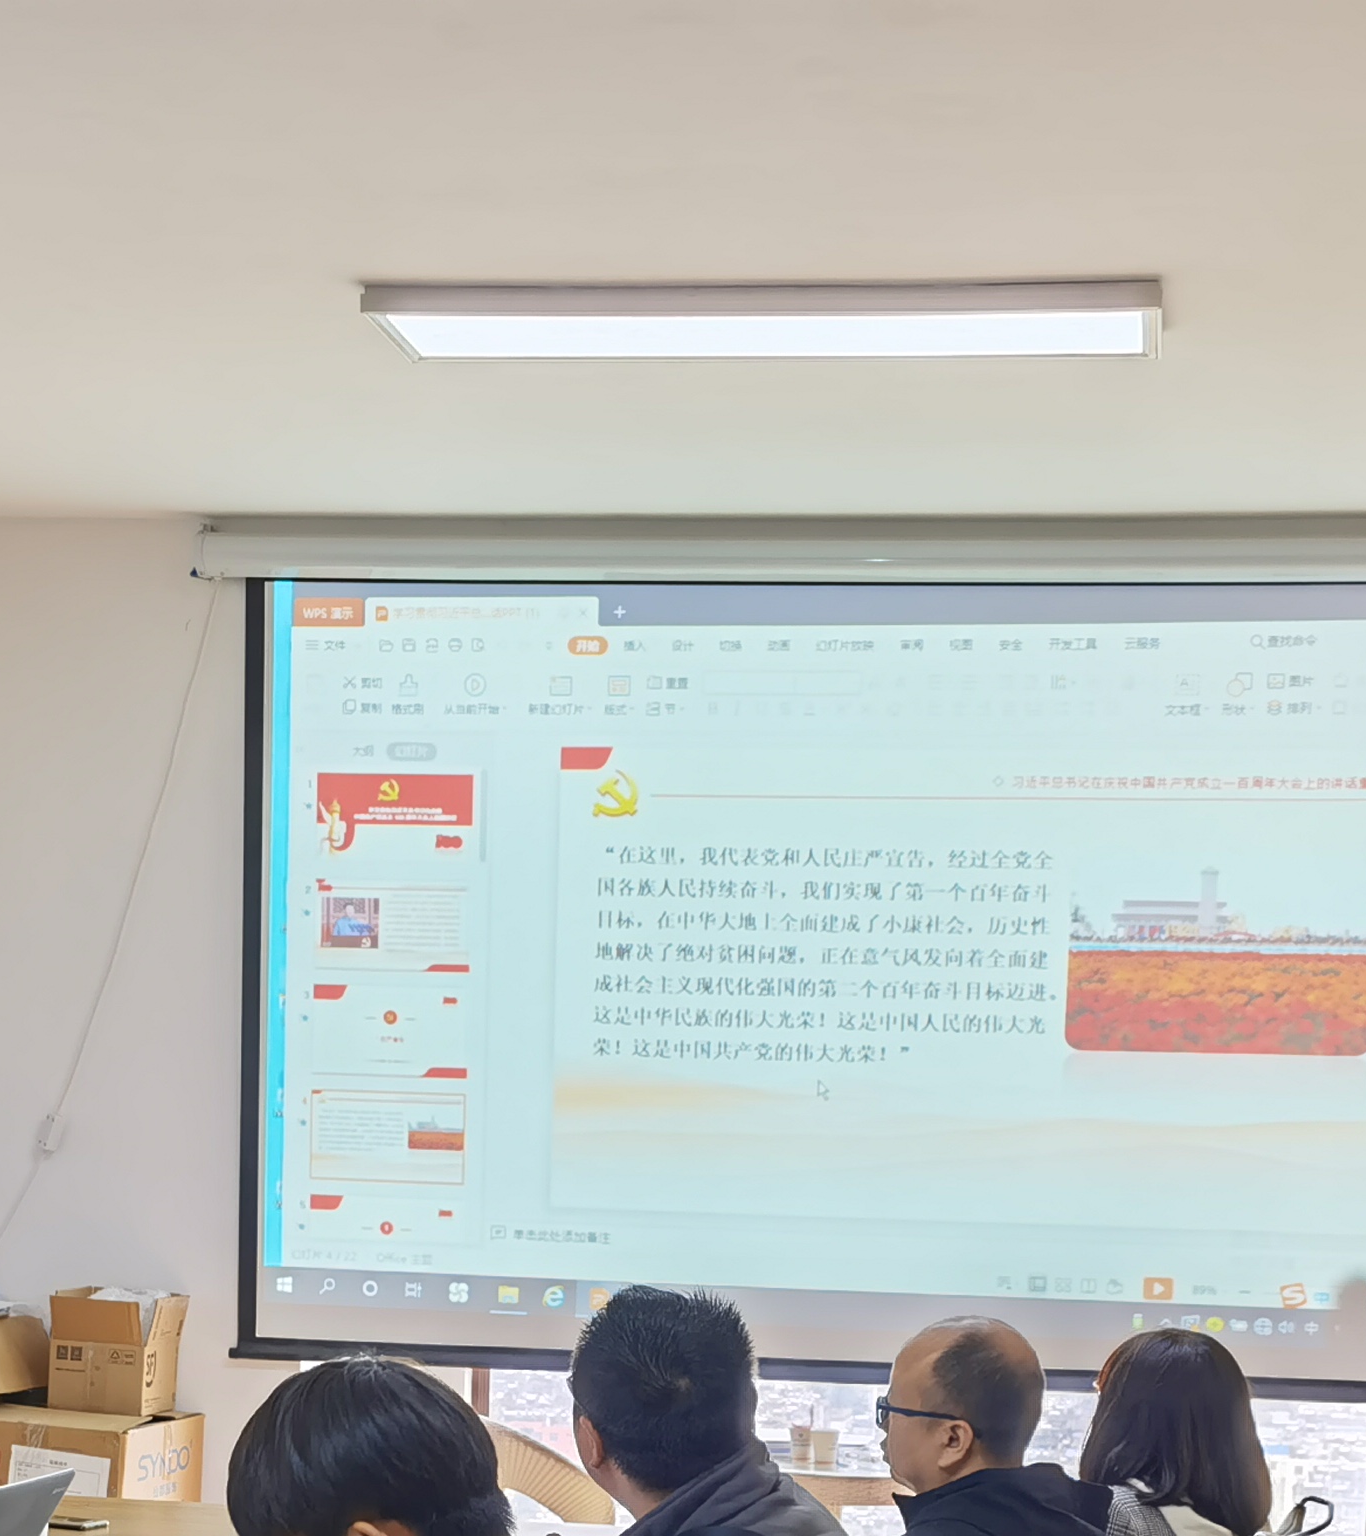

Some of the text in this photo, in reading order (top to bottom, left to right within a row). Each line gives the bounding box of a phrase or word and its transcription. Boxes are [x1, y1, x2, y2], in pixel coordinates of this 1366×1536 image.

[303, 606, 354, 620] WPS 演示
[323, 640, 346, 651] 文件
[575, 640, 601, 653] 开始
[999, 639, 1023, 651] 安全
[1048, 638, 1097, 651] 开发工具
[1124, 637, 1161, 650] 云服务
[597, 877, 1051, 903] 国各族人民持续奋斗，我们实现了第一个百年奋斗
[597, 910, 1051, 936] 目标，在中华大地上全面建成了小康社会，历史性
[595, 942, 1050, 970] 地解决了绝对贫困问题，正在意气风发向着全面建
[594, 975, 1057, 1002] 成社会主义现代化强国的第二个百年奋斗目标迈进。
[593, 1006, 1046, 1034] 这是中华民族的伟大光荣！这是中国人民的伟大光
